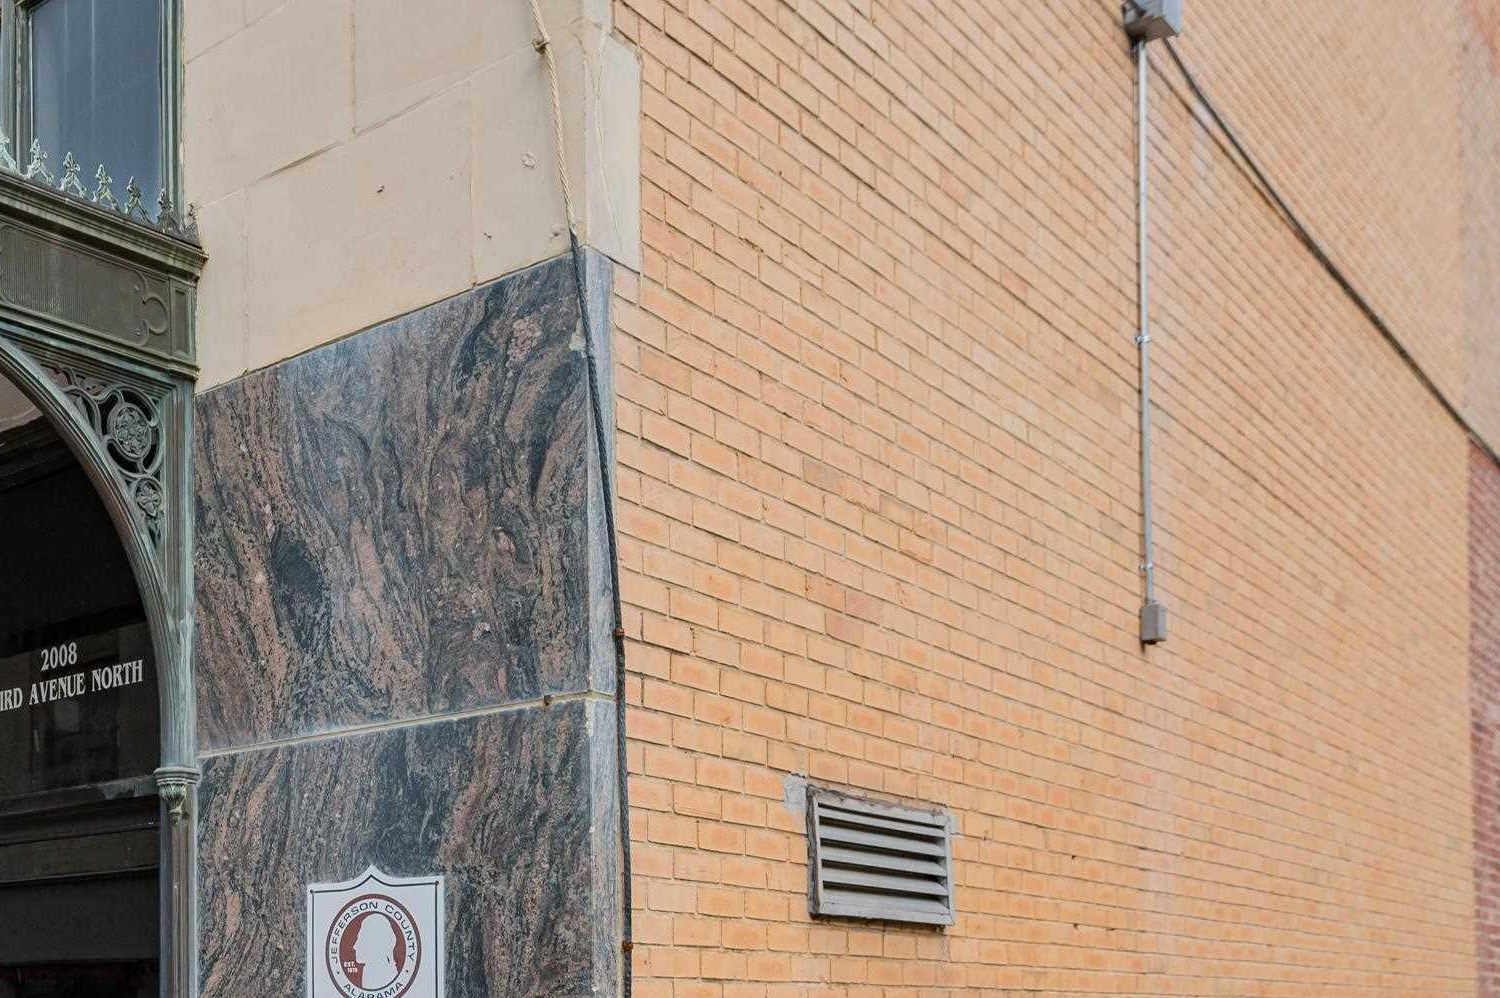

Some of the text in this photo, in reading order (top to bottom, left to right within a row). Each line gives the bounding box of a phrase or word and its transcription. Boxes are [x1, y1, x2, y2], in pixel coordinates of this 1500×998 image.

[40, 642, 77, 671] 2008
[29, 673, 86, 705] AVENUE
[92, 659, 143, 692] NORTH
[331, 902, 415, 964] JEFFERSON COUNTY
